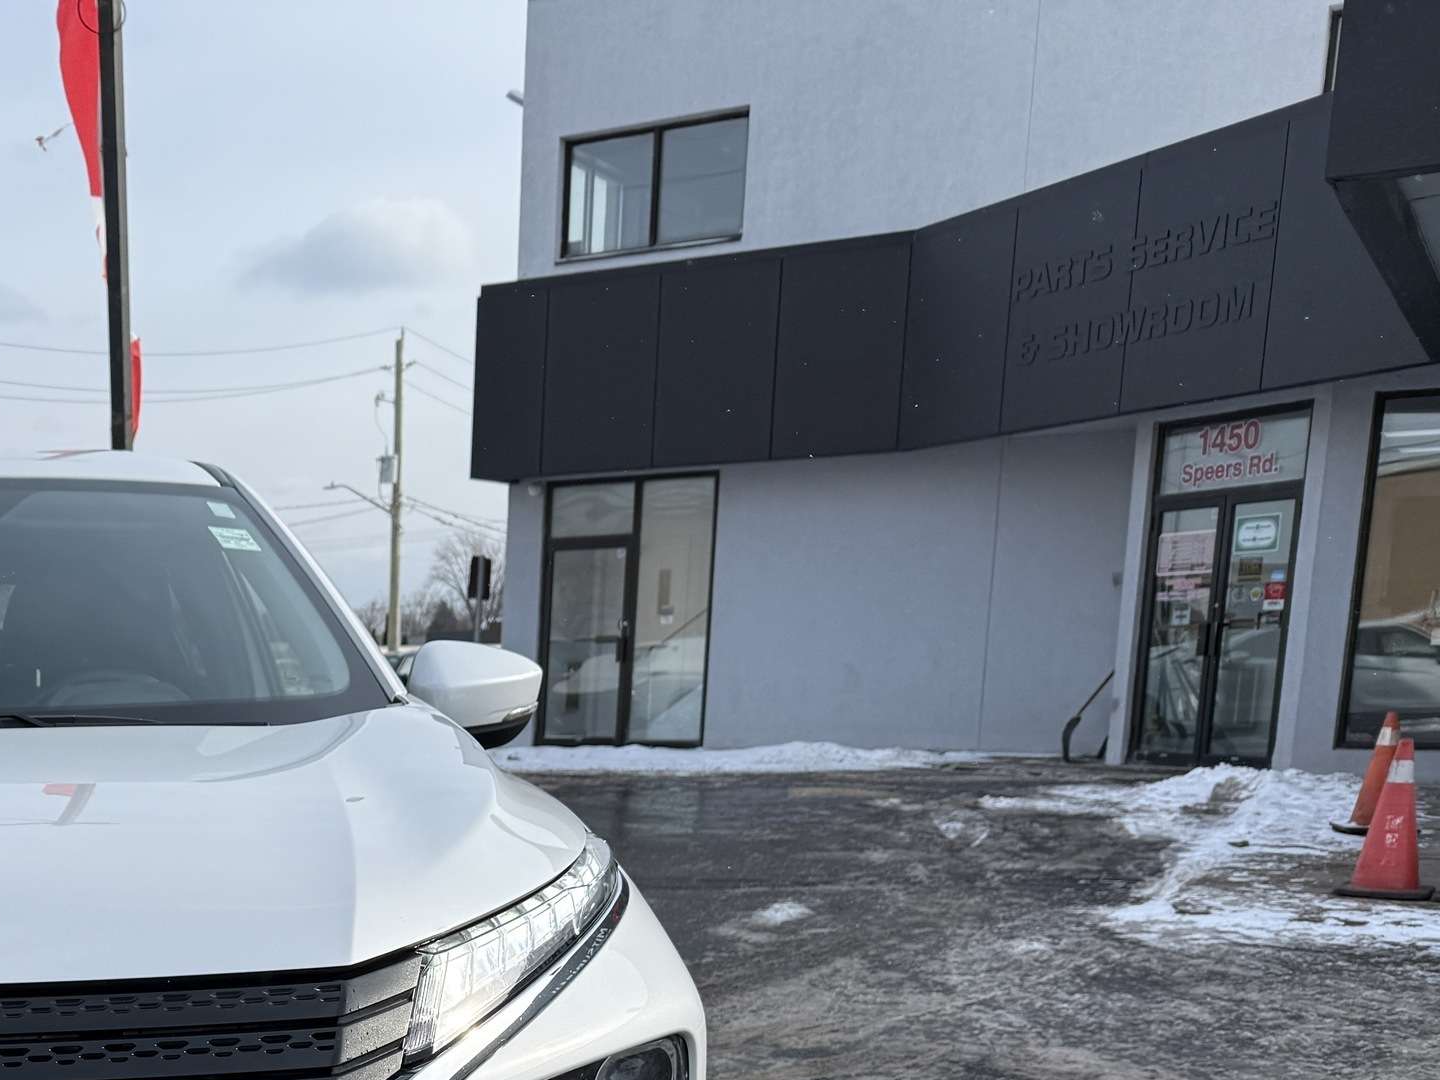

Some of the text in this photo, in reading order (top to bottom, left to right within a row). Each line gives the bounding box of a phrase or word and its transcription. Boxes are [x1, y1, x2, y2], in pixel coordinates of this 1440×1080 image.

[1013, 200, 1279, 302] PARTS SERVICE
[1016, 281, 1256, 367] & SHOWROOM
[1200, 419, 1262, 456] 1450
[1182, 452, 1280, 488] Speers Rd.
